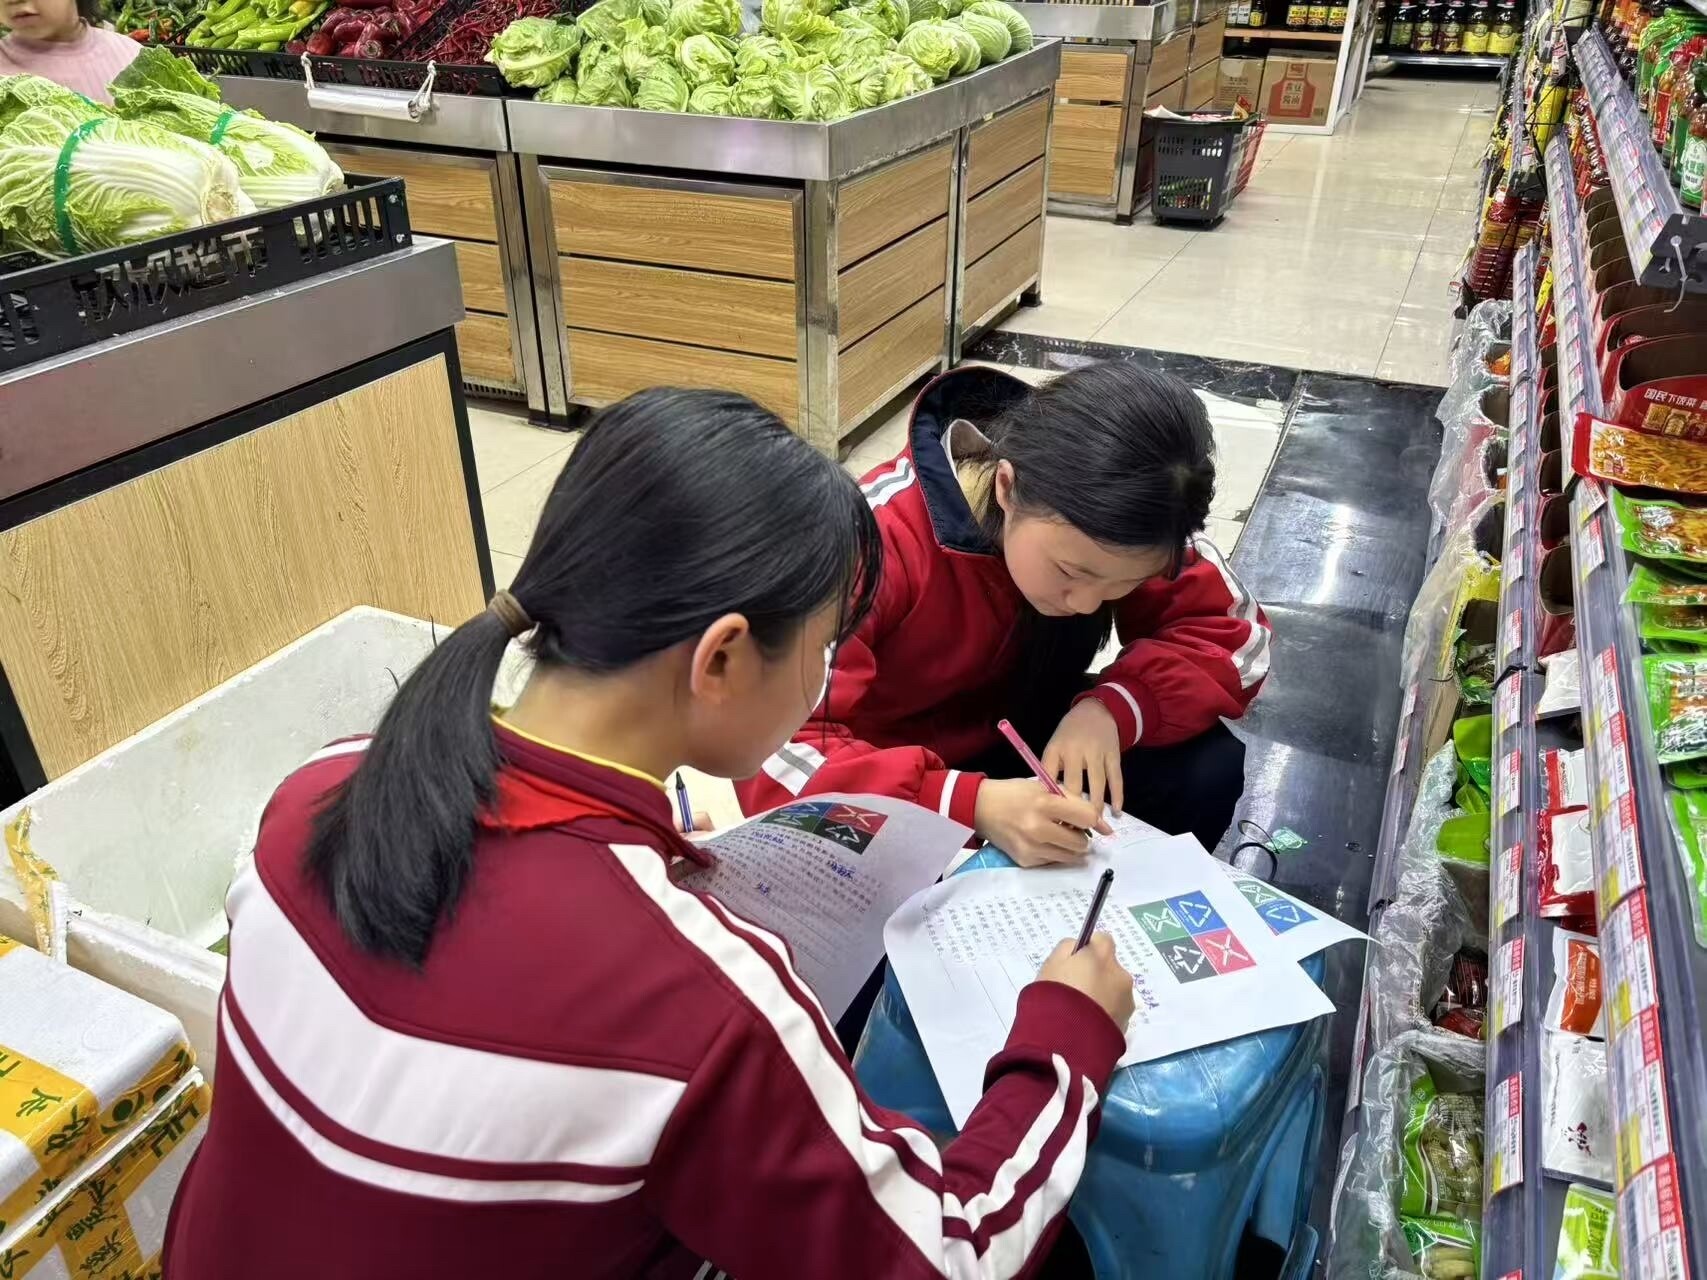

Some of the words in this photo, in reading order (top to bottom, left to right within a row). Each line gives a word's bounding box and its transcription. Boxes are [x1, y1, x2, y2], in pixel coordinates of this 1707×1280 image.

[1644, 388, 1697, 408] 国民下饭菜
